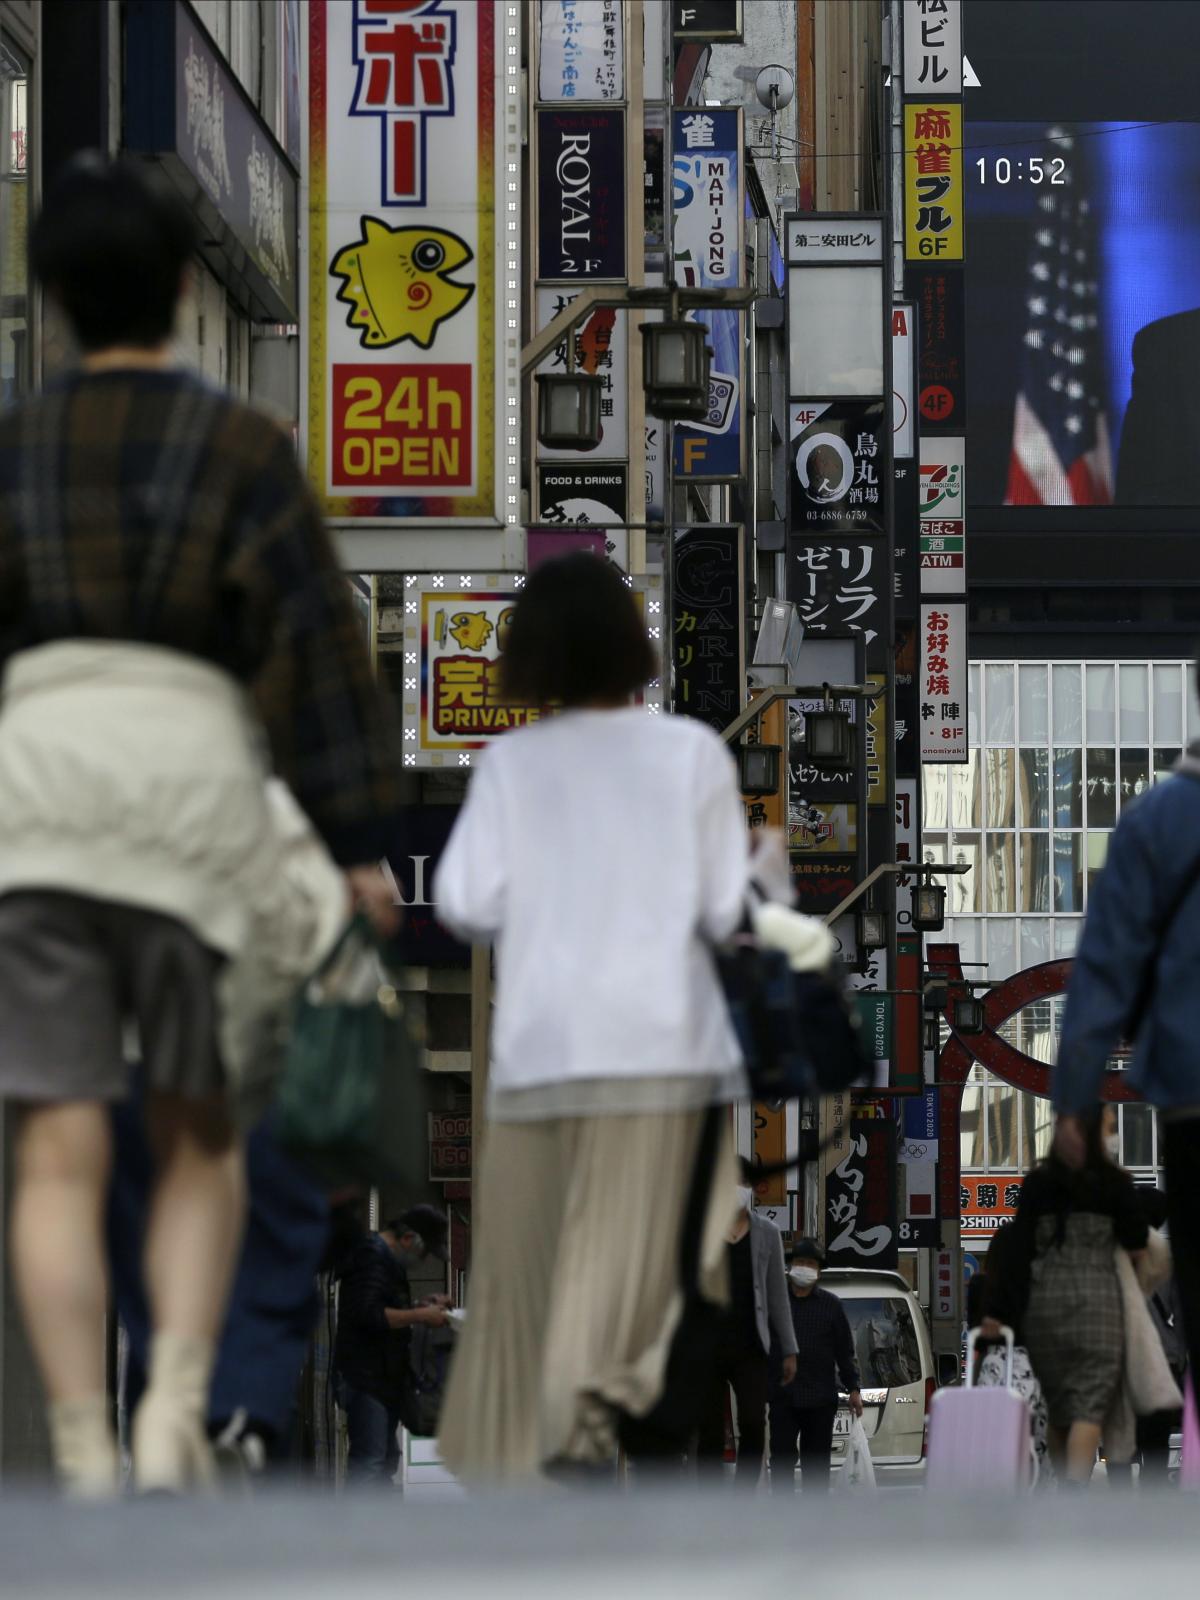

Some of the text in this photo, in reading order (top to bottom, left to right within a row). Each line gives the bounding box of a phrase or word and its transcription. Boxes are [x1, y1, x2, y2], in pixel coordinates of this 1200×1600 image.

[364, 0, 446, 196] ボー
[976, 157, 1065, 184] 10:52
[556, 132, 591, 255] ROYAL
[795, 233, 876, 247] 第二安田ビル
[918, 238, 948, 256] 6F
[560, 260, 602, 272] 2F
[343, 377, 462, 430] 24h
[795, 410, 817, 424] 4F
[342, 437, 460, 476] OPEN
[545, 475, 622, 485] FOOD & DRINKS
[806, 510, 867, 521] 03-6886-6759
[920, 522, 955, 535] たばこ
[928, 538, 945, 551] 酒
[920, 555, 952, 567] ATM
[926, 611, 950, 696] お好み焼
[438, 708, 541, 728] PRIVATE
[874, 1001, 885, 1057] TOKYO 2020
[926, 1117, 934, 1137] 2020
